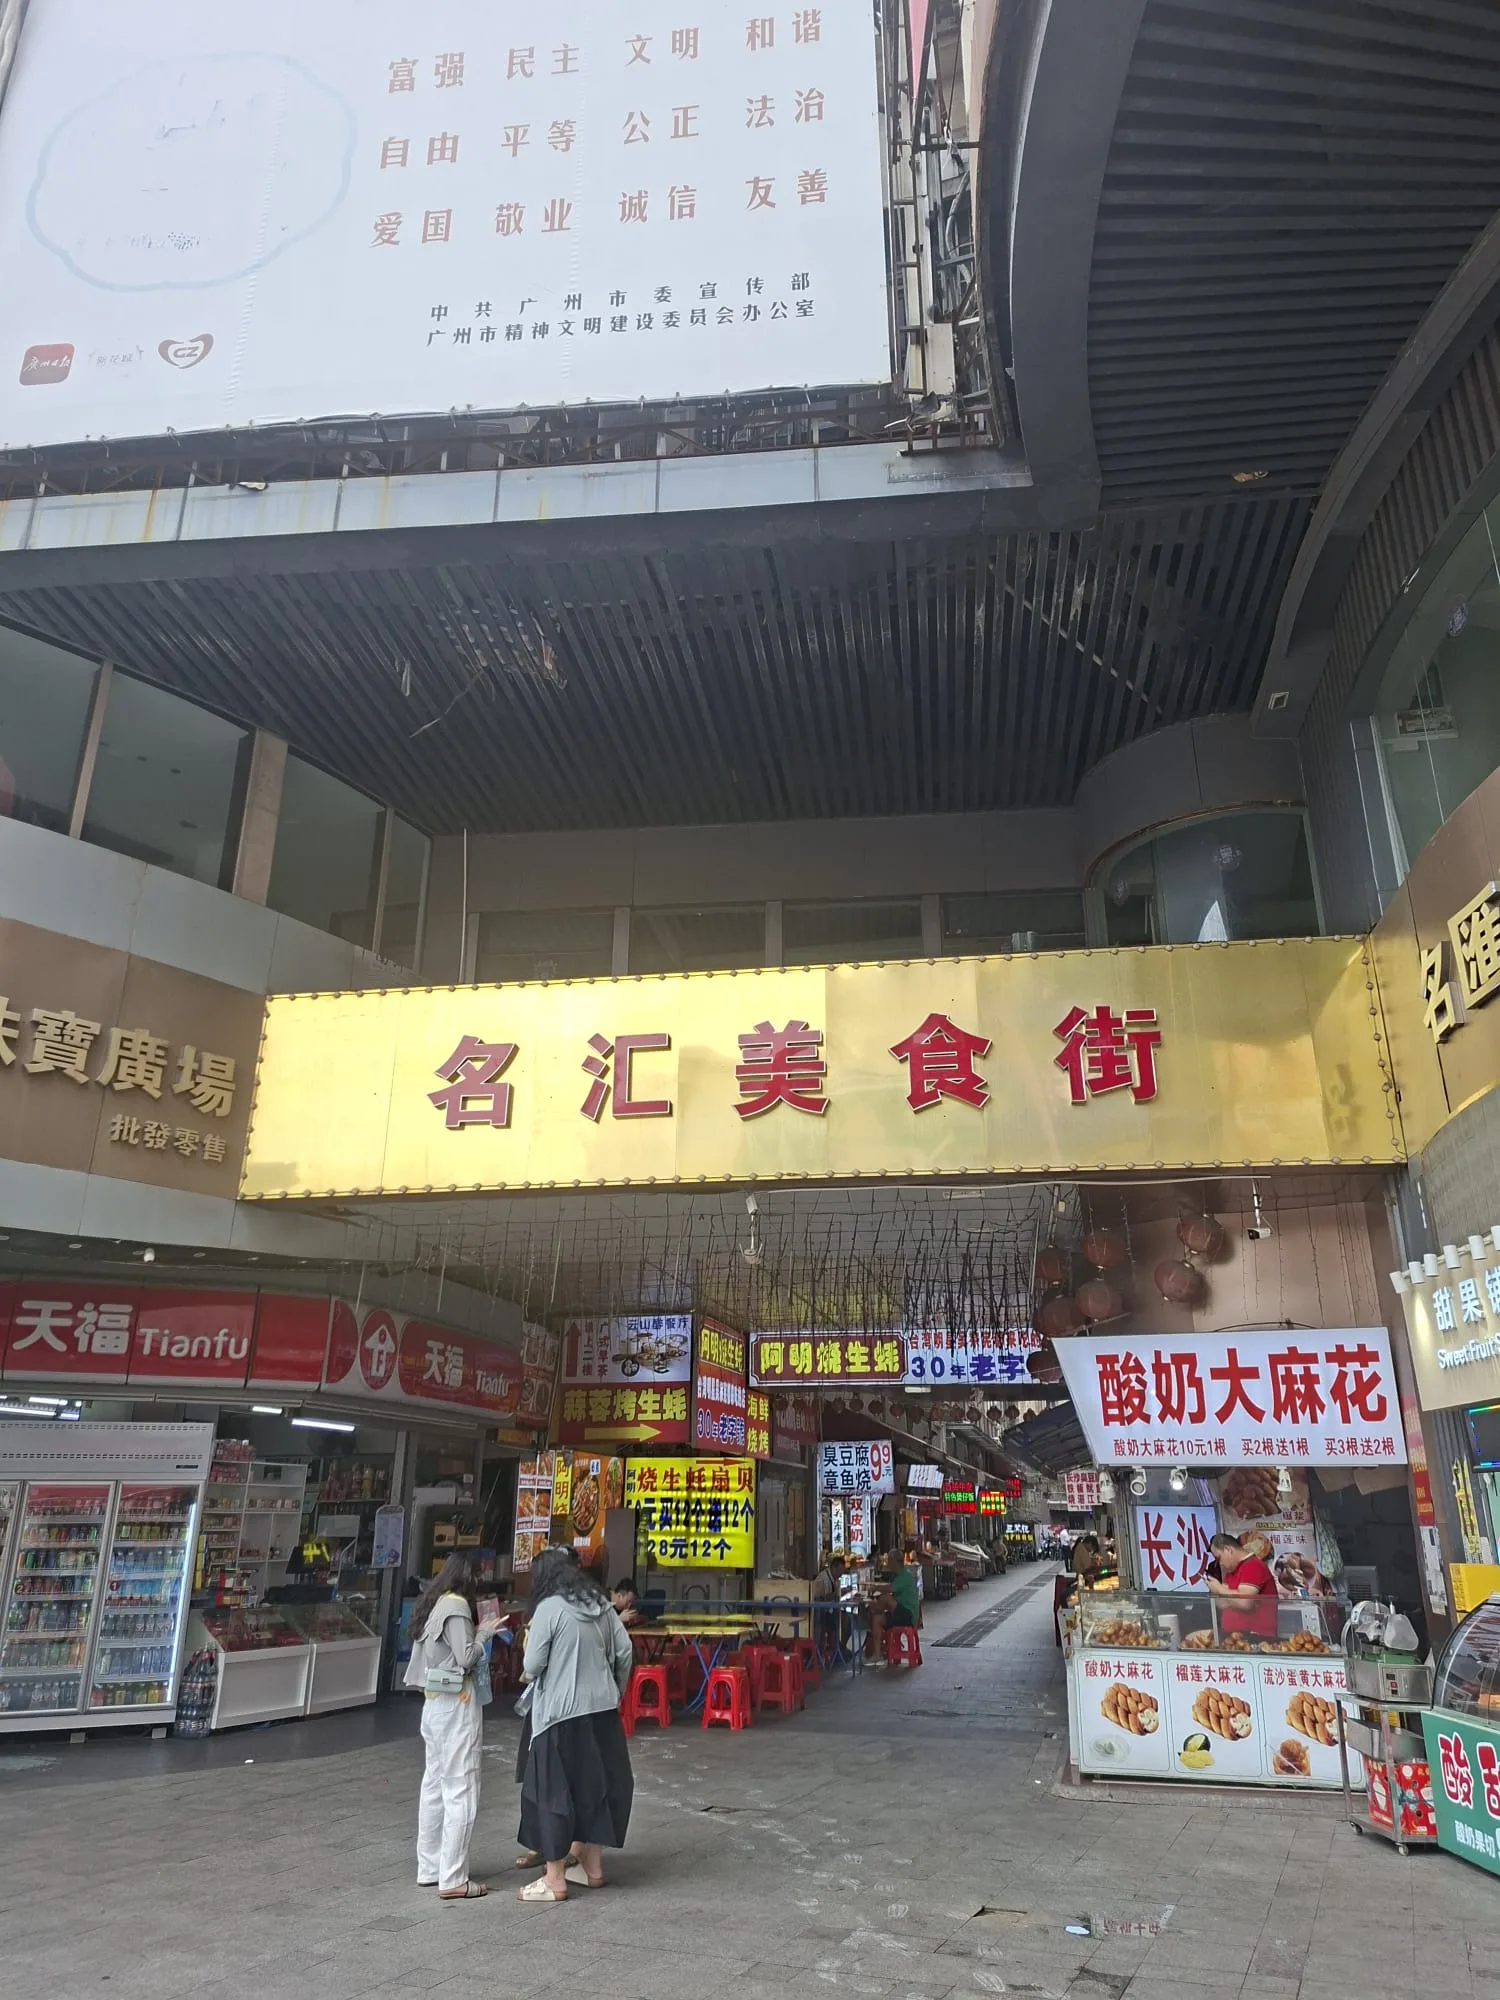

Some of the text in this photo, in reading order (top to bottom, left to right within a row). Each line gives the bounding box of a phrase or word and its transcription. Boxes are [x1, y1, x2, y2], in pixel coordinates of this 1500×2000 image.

[387, 8, 824, 94] 富强 民主 文明 和谐
[379, 87, 826, 169] 自由 平等 公正 法治
[368, 168, 829, 248] 爱国 敬业 诚信 友善
[430, 272, 812, 322] 中共广州市委宣传部
[426, 298, 817, 347] 广州市精神文明建设委员会办公室
[426, 1004, 1164, 1130] 名汇美食街
[110, 1113, 228, 1163] 批發零售
[12, 1300, 133, 1354] 天福
[138, 1328, 249, 1360] Tianfu
[423, 1339, 464, 1388] 天福
[475, 1369, 510, 1397] Tianfu
[1096, 1343, 1388, 1427] 酸奶大麻花
[747, 1394, 769, 1423] 海鲜
[824, 1446, 869, 1467] 臭豆腐
[1113, 1437, 1396, 1457] 酸奶大麻花10元1根 买2根送1根 买3根送2根
[637, 1466, 753, 1494] 烧生蚝扇贝
[824, 1469, 871, 1491] 章鱼烧
[850, 1498, 864, 1543] 双皮奶
[1140, 1511, 1211, 1586] 长沙
[1084, 1660, 1155, 1681] 酸奶大麻花
[1176, 1663, 1247, 1685] 榴莲大麻花
[1263, 1667, 1347, 1690] 流沙蛋黄大麻花
